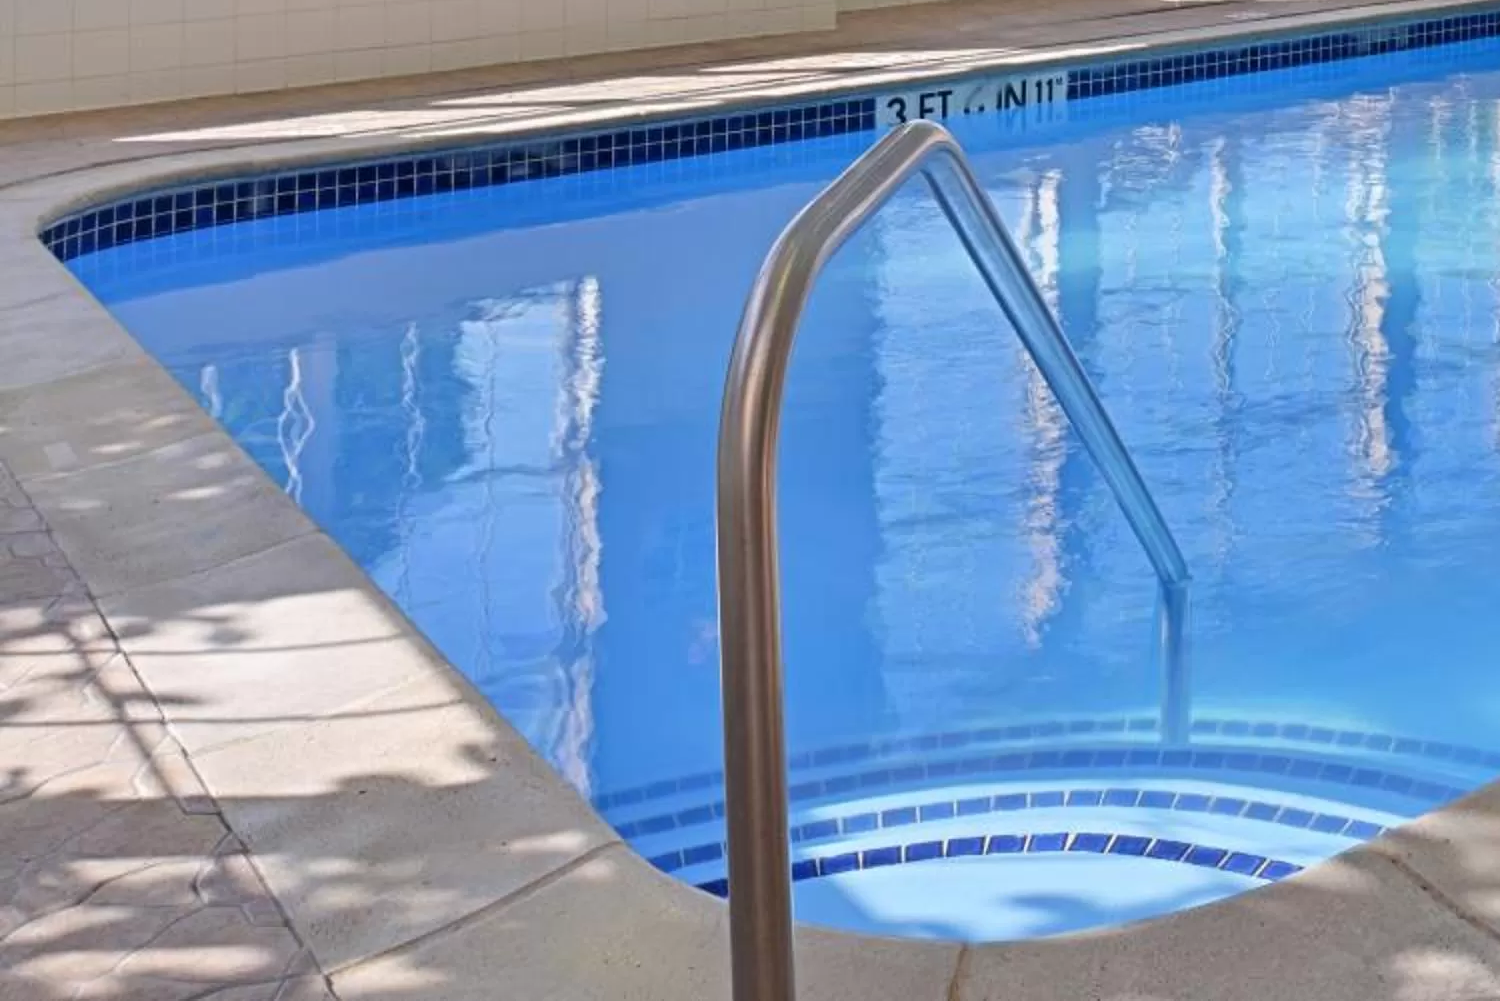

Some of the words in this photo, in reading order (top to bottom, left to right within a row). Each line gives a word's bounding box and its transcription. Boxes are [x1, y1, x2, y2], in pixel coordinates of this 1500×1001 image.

[886, 97, 907, 123] 3
[919, 90, 953, 119] FT
[996, 79, 1026, 109] IN
